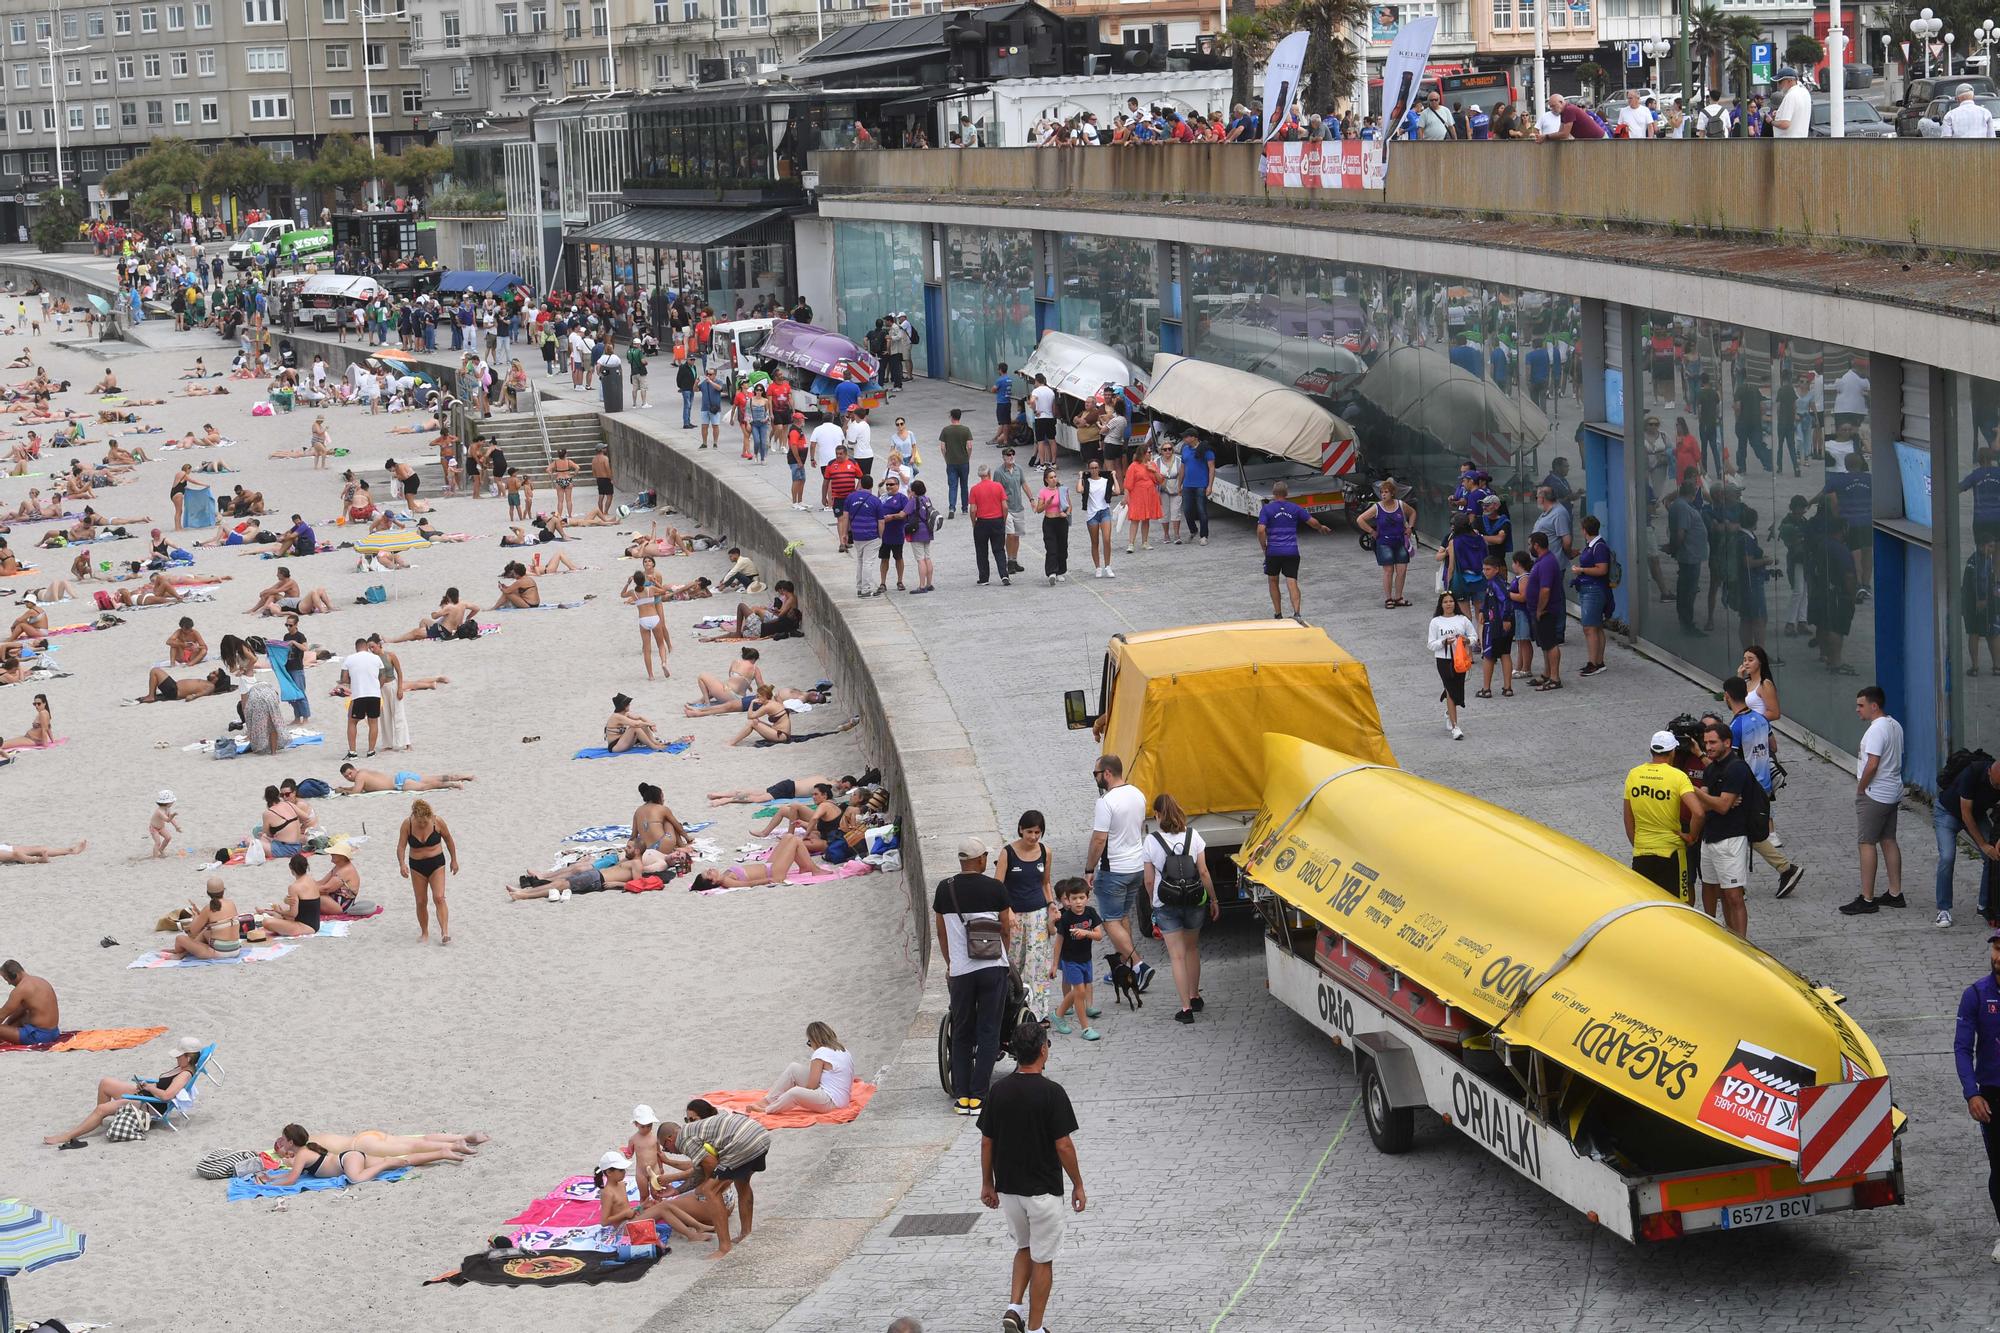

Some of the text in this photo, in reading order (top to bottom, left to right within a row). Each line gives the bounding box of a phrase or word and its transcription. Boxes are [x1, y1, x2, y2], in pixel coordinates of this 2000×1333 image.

[1628, 43, 1639, 60] P
[1755, 45, 1767, 61] P
[1631, 785, 1671, 801] ORIO!
[1325, 872, 1372, 917] PBX
[1377, 888, 1406, 914] Gipuzkoa
[1397, 923, 1429, 949] SETALDE
[1414, 912, 1442, 933] GROUP
[1318, 983, 1354, 1037] ORIO
[1551, 991, 1591, 1015] IPAR LUR
[1607, 1011, 1698, 1058] Euskal Sukaldariak
[1572, 1017, 1698, 1100] SAGARDI
[1721, 1076, 1775, 1115] LIGA
[1713, 1095, 1767, 1126] EUSKO LABEL
[1453, 1072, 1542, 1181] ORIALKI
[1732, 1198, 1811, 1225] 6572 BCV
